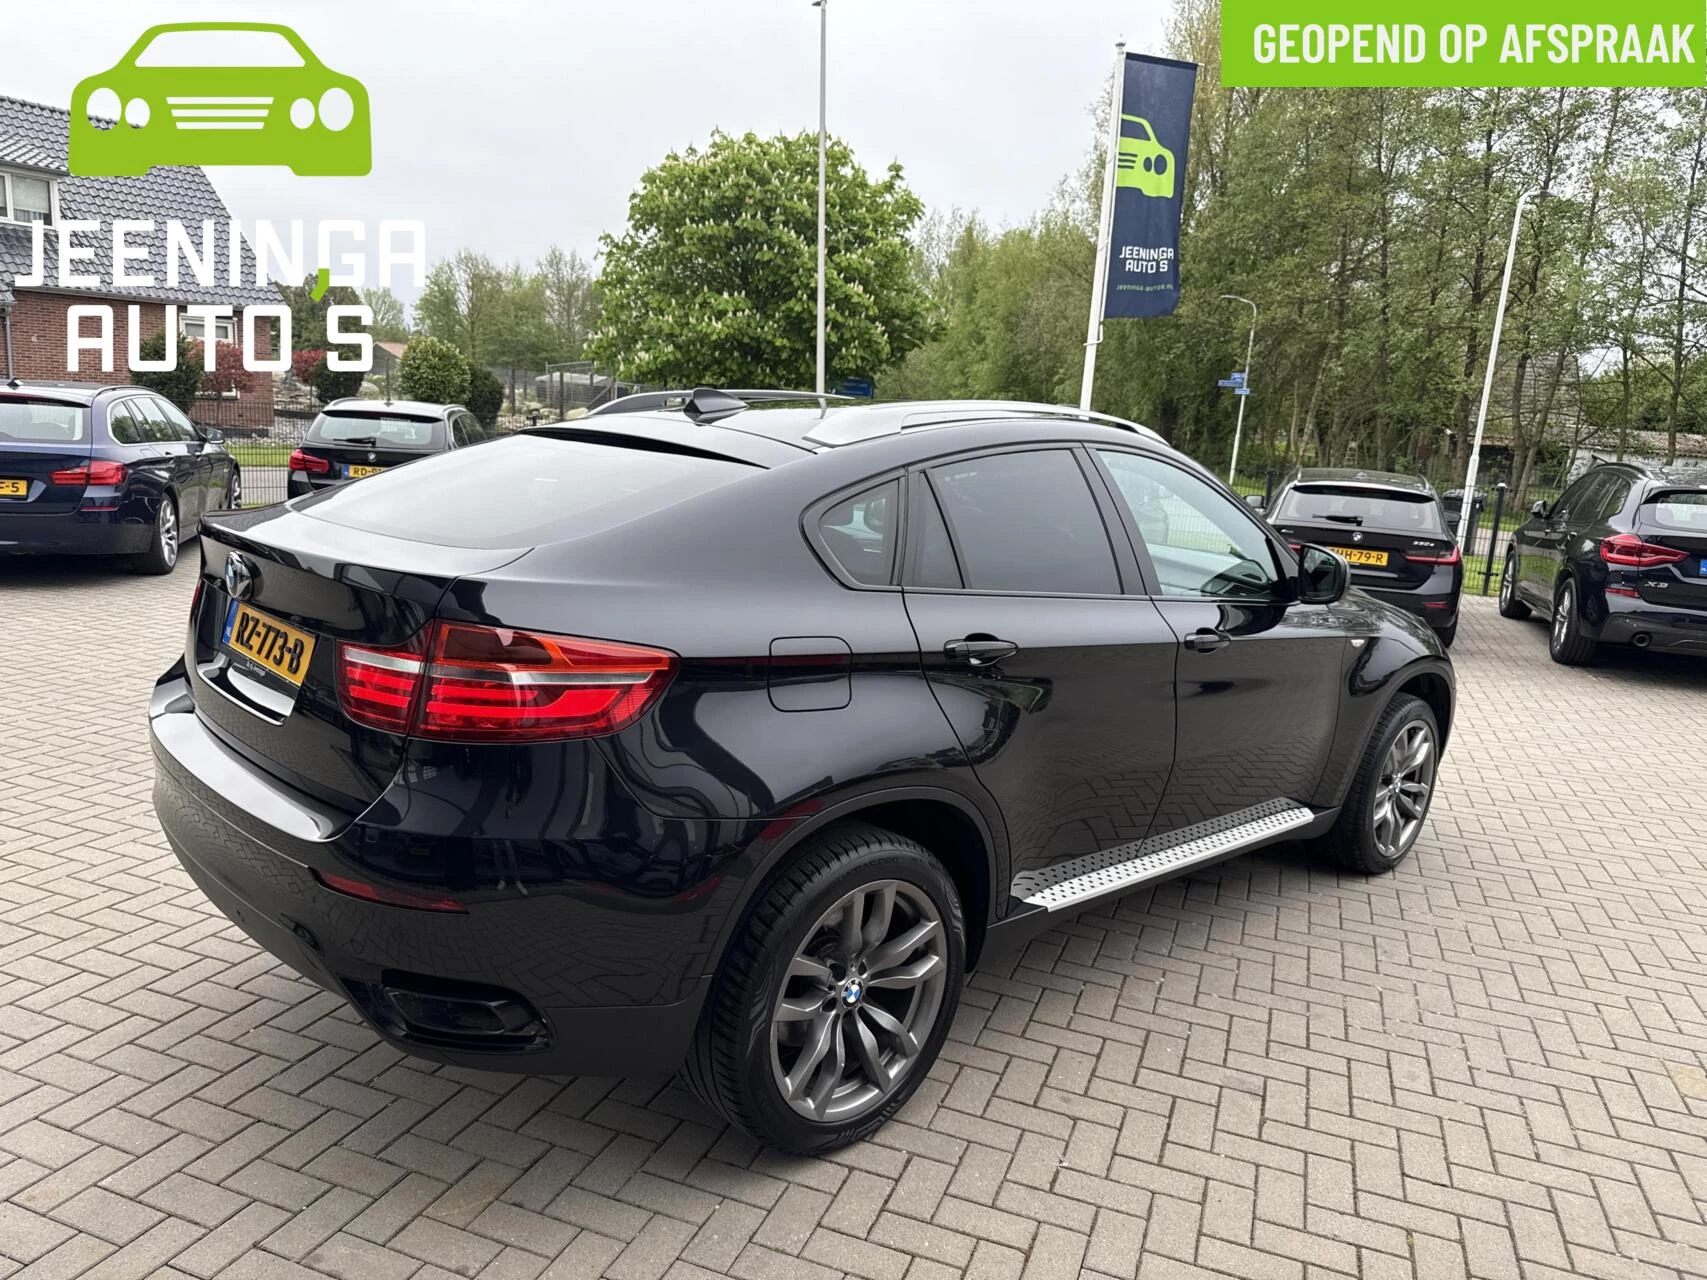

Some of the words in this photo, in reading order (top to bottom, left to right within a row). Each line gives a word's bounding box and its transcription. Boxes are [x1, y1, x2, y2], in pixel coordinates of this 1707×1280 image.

[1119, 246, 1175, 261] JEENINGA
[1331, 548, 1384, 564] HH-79-R
[235, 611, 306, 675] RZ-773-B
